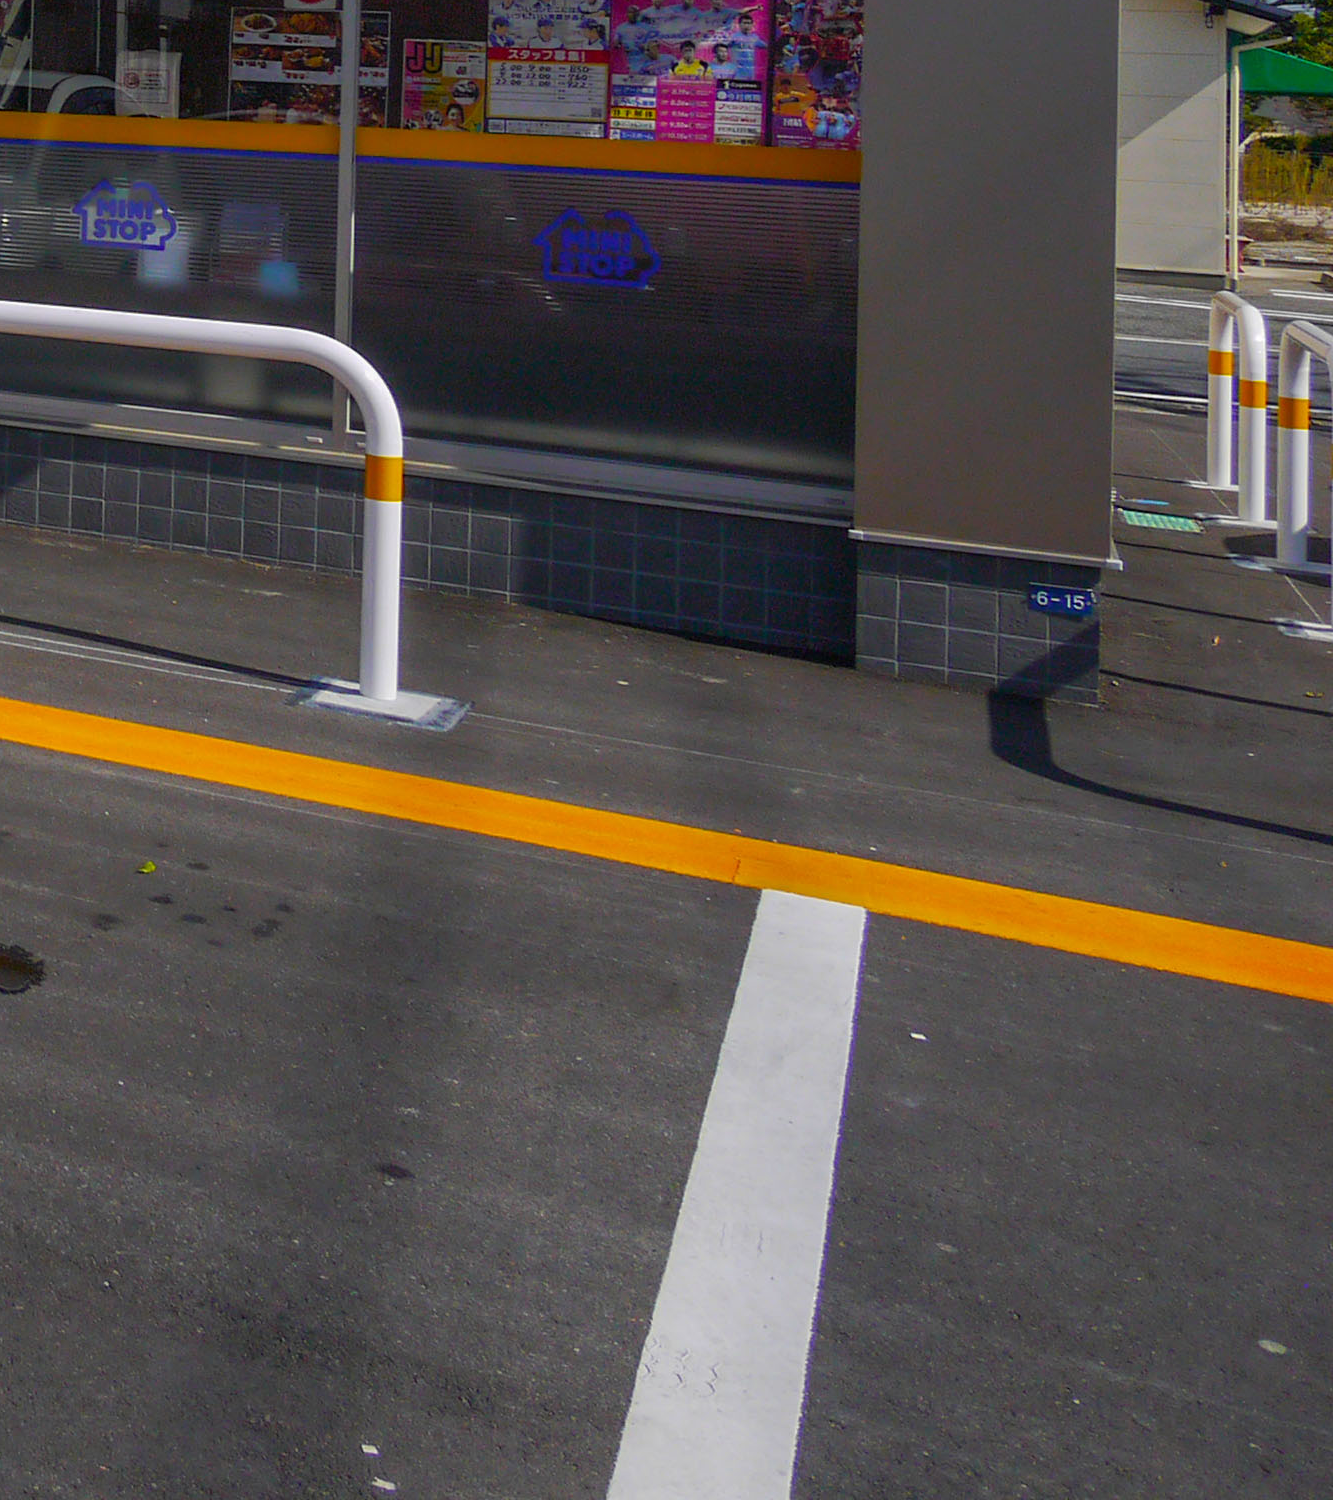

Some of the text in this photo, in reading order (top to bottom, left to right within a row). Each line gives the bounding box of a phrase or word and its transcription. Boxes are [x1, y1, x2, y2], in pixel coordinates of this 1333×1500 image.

[93, 197, 157, 240] MINI STOP
[559, 227, 635, 276] MINI STOP
[1036, 590, 1086, 611] 6-15
